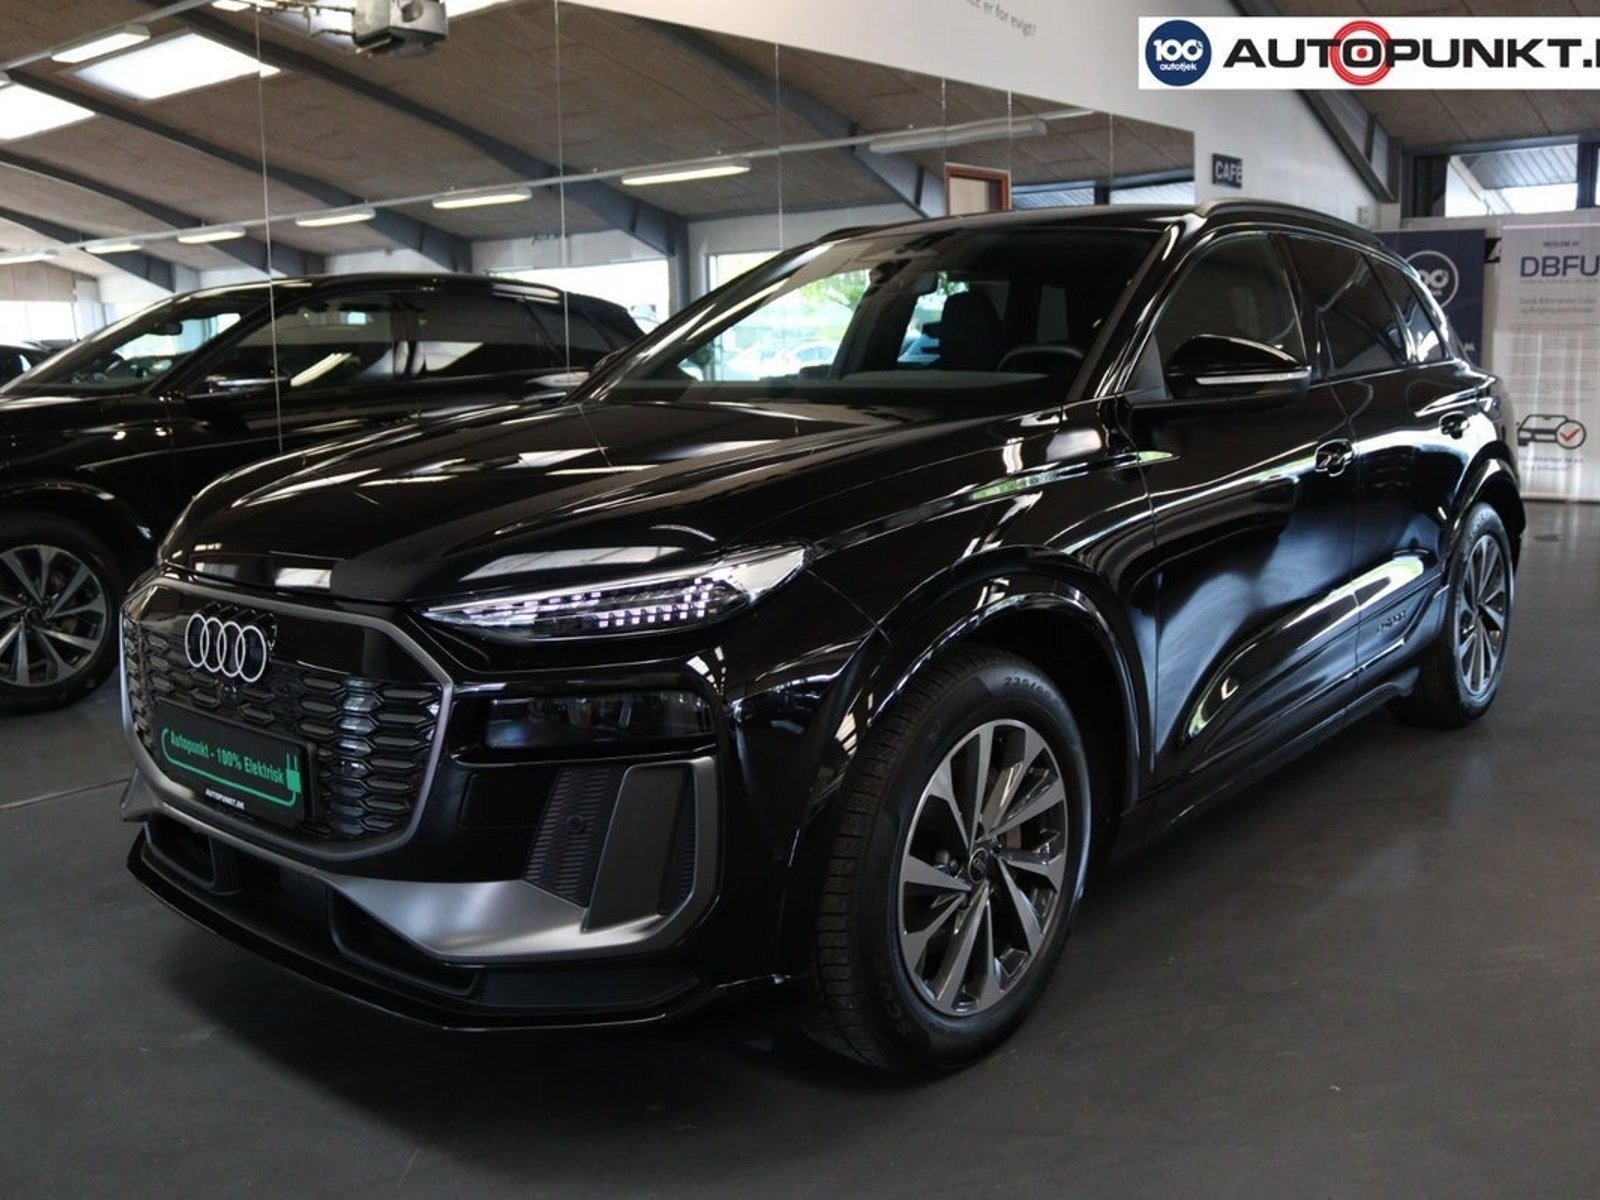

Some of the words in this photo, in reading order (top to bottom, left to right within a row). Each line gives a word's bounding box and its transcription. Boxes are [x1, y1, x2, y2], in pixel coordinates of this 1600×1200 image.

[1520, 254, 1600, 278] DBFU
[170, 731, 209, 759] Autopunkt
[217, 747, 242, 771] 100%
[244, 756, 285, 785] Elektrisk
